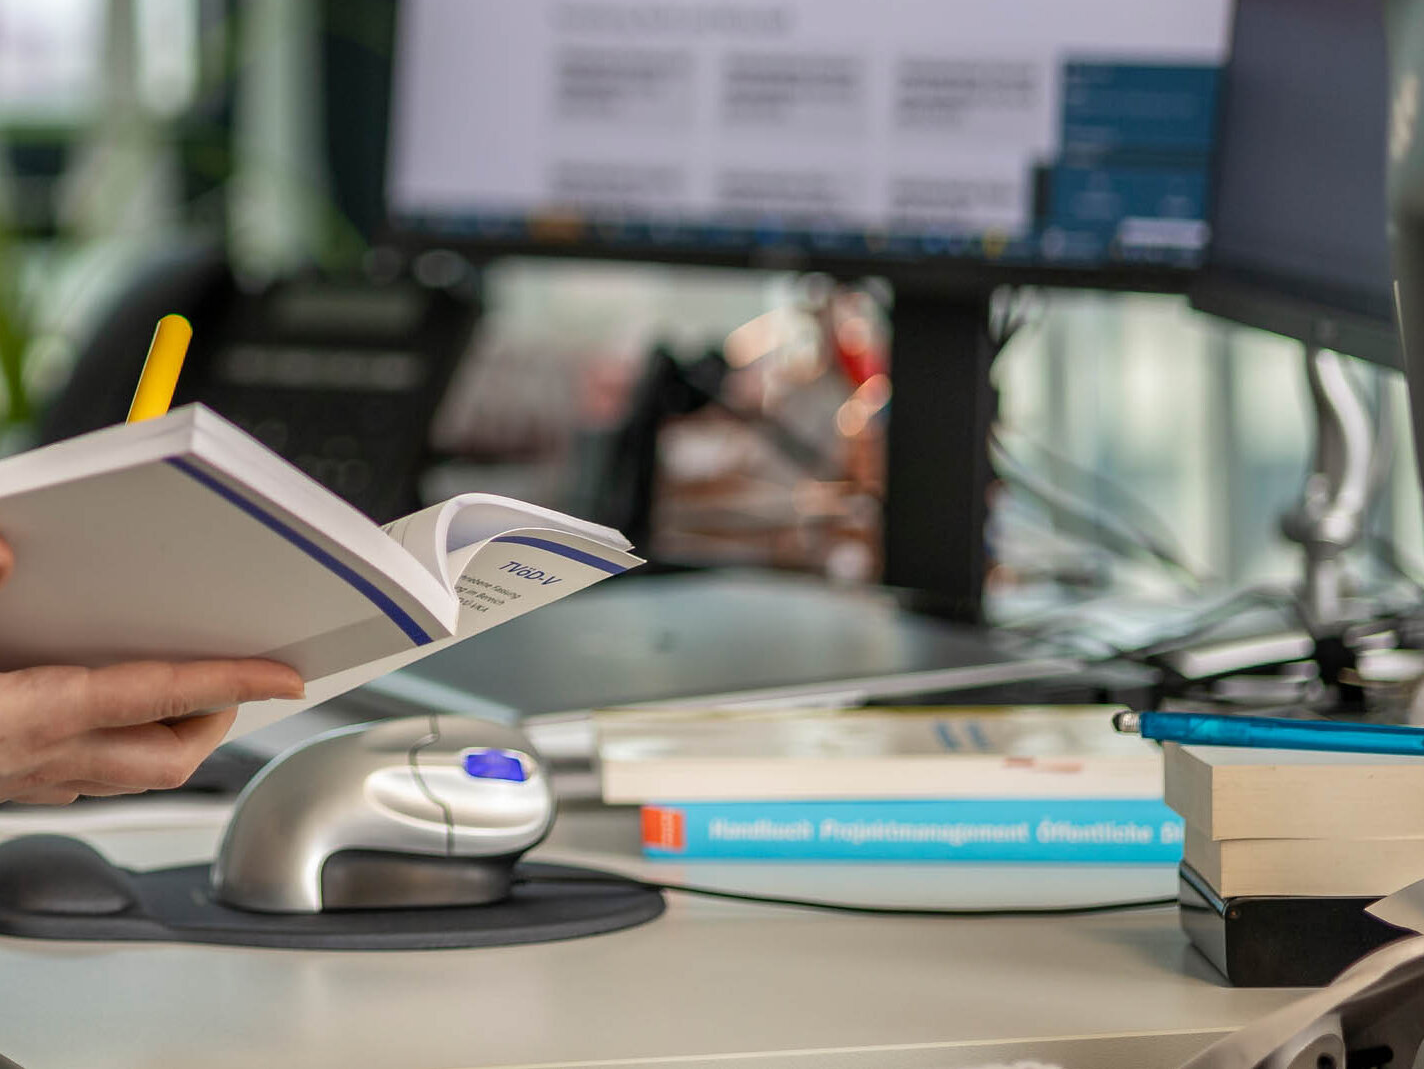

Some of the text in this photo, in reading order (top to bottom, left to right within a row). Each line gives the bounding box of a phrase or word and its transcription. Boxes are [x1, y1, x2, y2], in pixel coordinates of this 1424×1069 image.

[499, 561, 562, 585] TVöD-V
[708, 818, 815, 841] Handbuch
[819, 818, 1030, 846] Projektmanagement
[1036, 815, 1154, 844] Öffentliche
